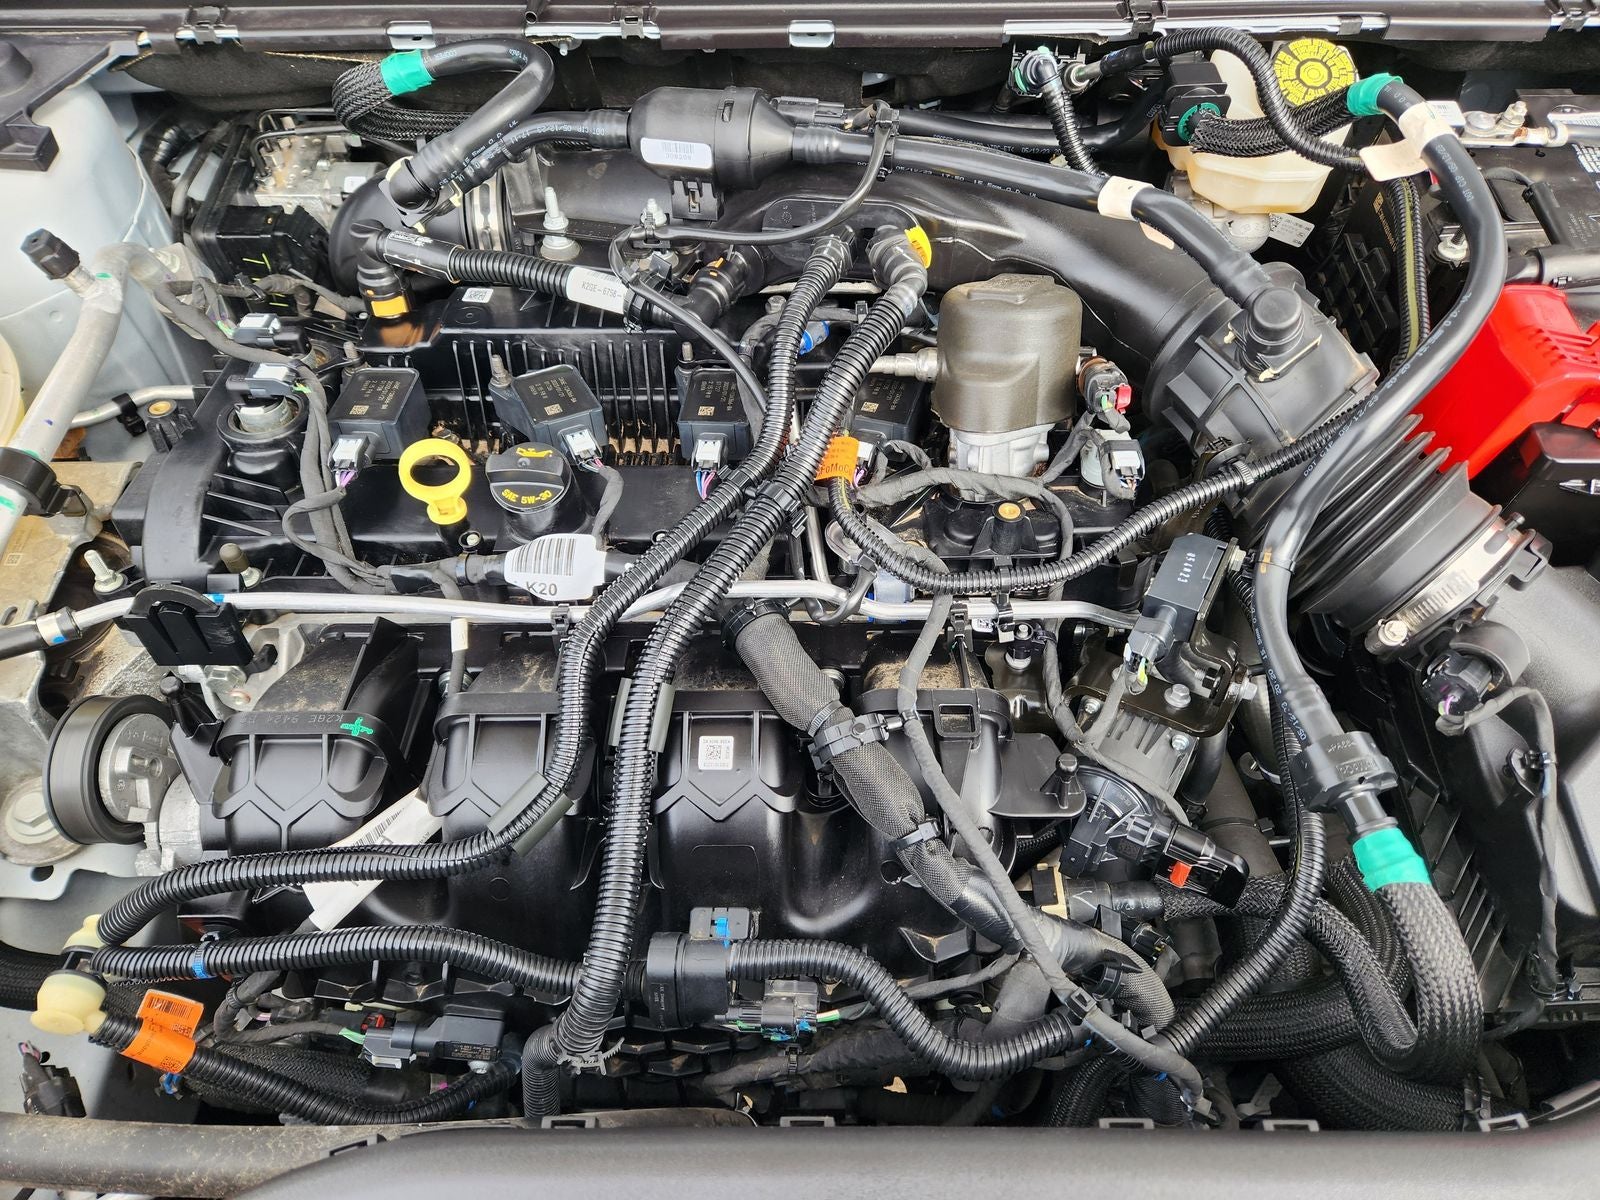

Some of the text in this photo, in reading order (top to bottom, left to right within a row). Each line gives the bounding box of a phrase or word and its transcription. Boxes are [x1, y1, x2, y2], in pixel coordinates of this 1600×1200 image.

[1302, 460, 1319, 478] DOT
[501, 488, 553, 505] SAE 5W-30
[526, 581, 558, 597] K20
